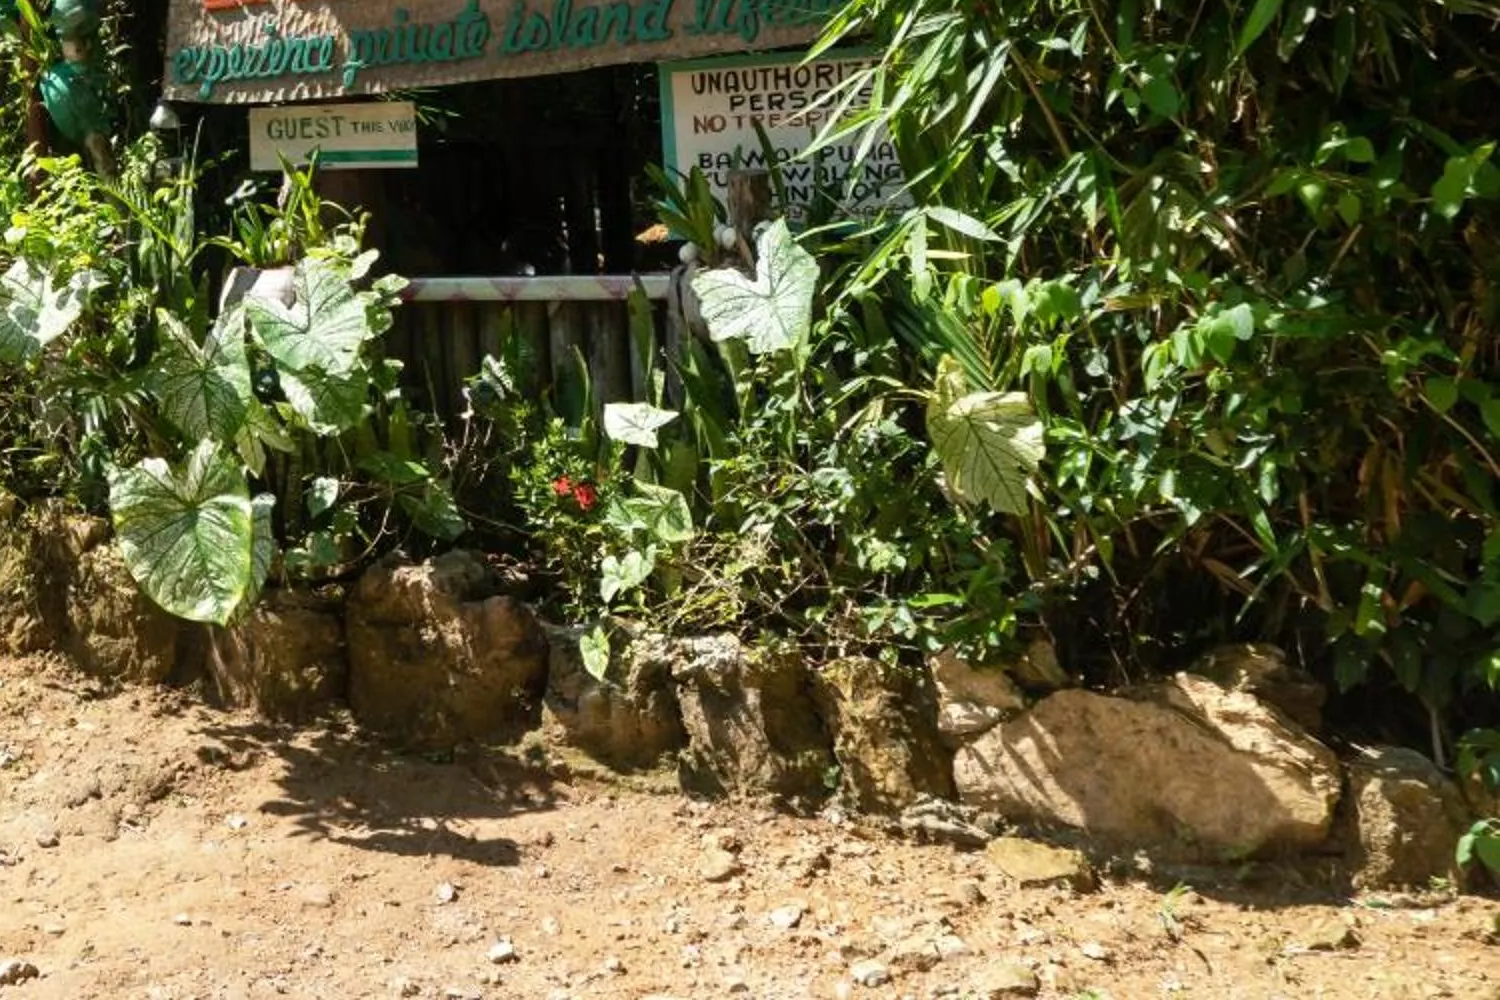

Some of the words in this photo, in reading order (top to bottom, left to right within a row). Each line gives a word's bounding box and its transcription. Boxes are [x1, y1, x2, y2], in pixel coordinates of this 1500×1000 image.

[173, 23, 335, 98] experience
[691, 59, 882, 95] UNAUTHORIZ
[266, 115, 345, 140] GUEST
[350, 120, 385, 134] THIS
[692, 114, 727, 135] NO
[783, 163, 902, 184] WALNG
